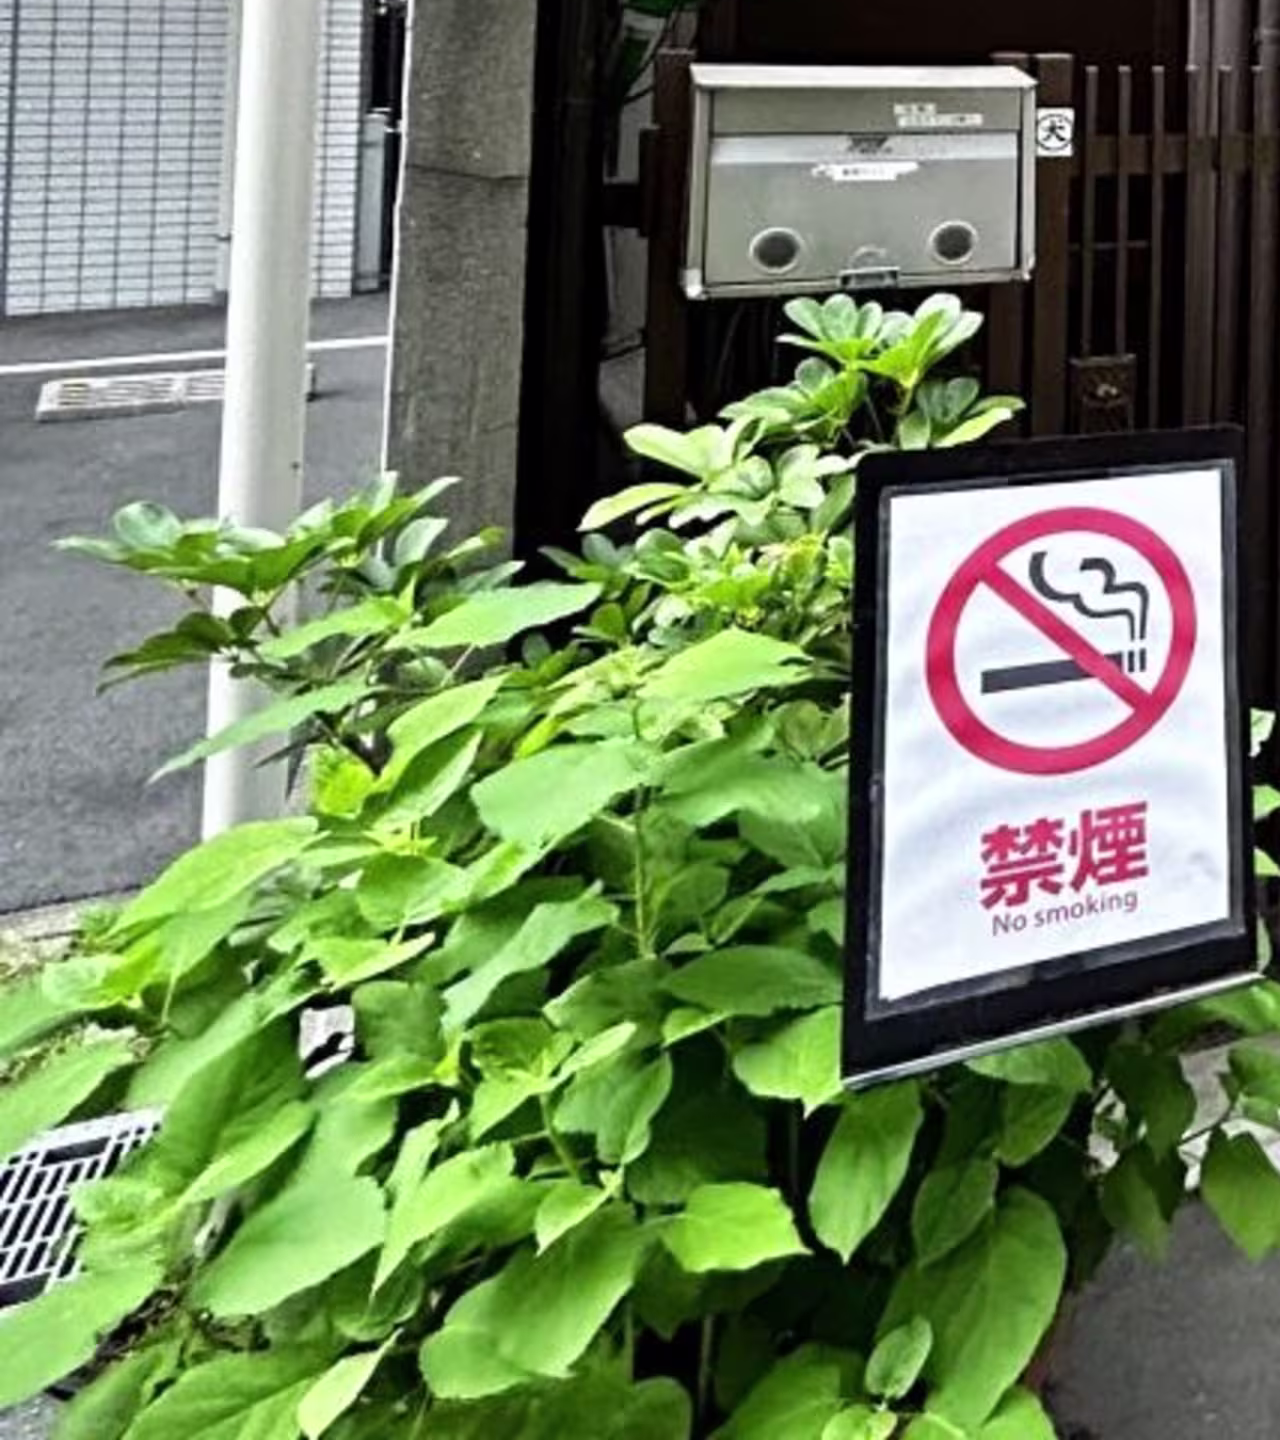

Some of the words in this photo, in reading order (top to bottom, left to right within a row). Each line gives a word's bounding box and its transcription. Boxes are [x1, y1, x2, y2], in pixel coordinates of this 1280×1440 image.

[980, 801, 1148, 910] 禁煙
[992, 913, 1027, 936] No
[1034, 891, 1138, 927] smoking
